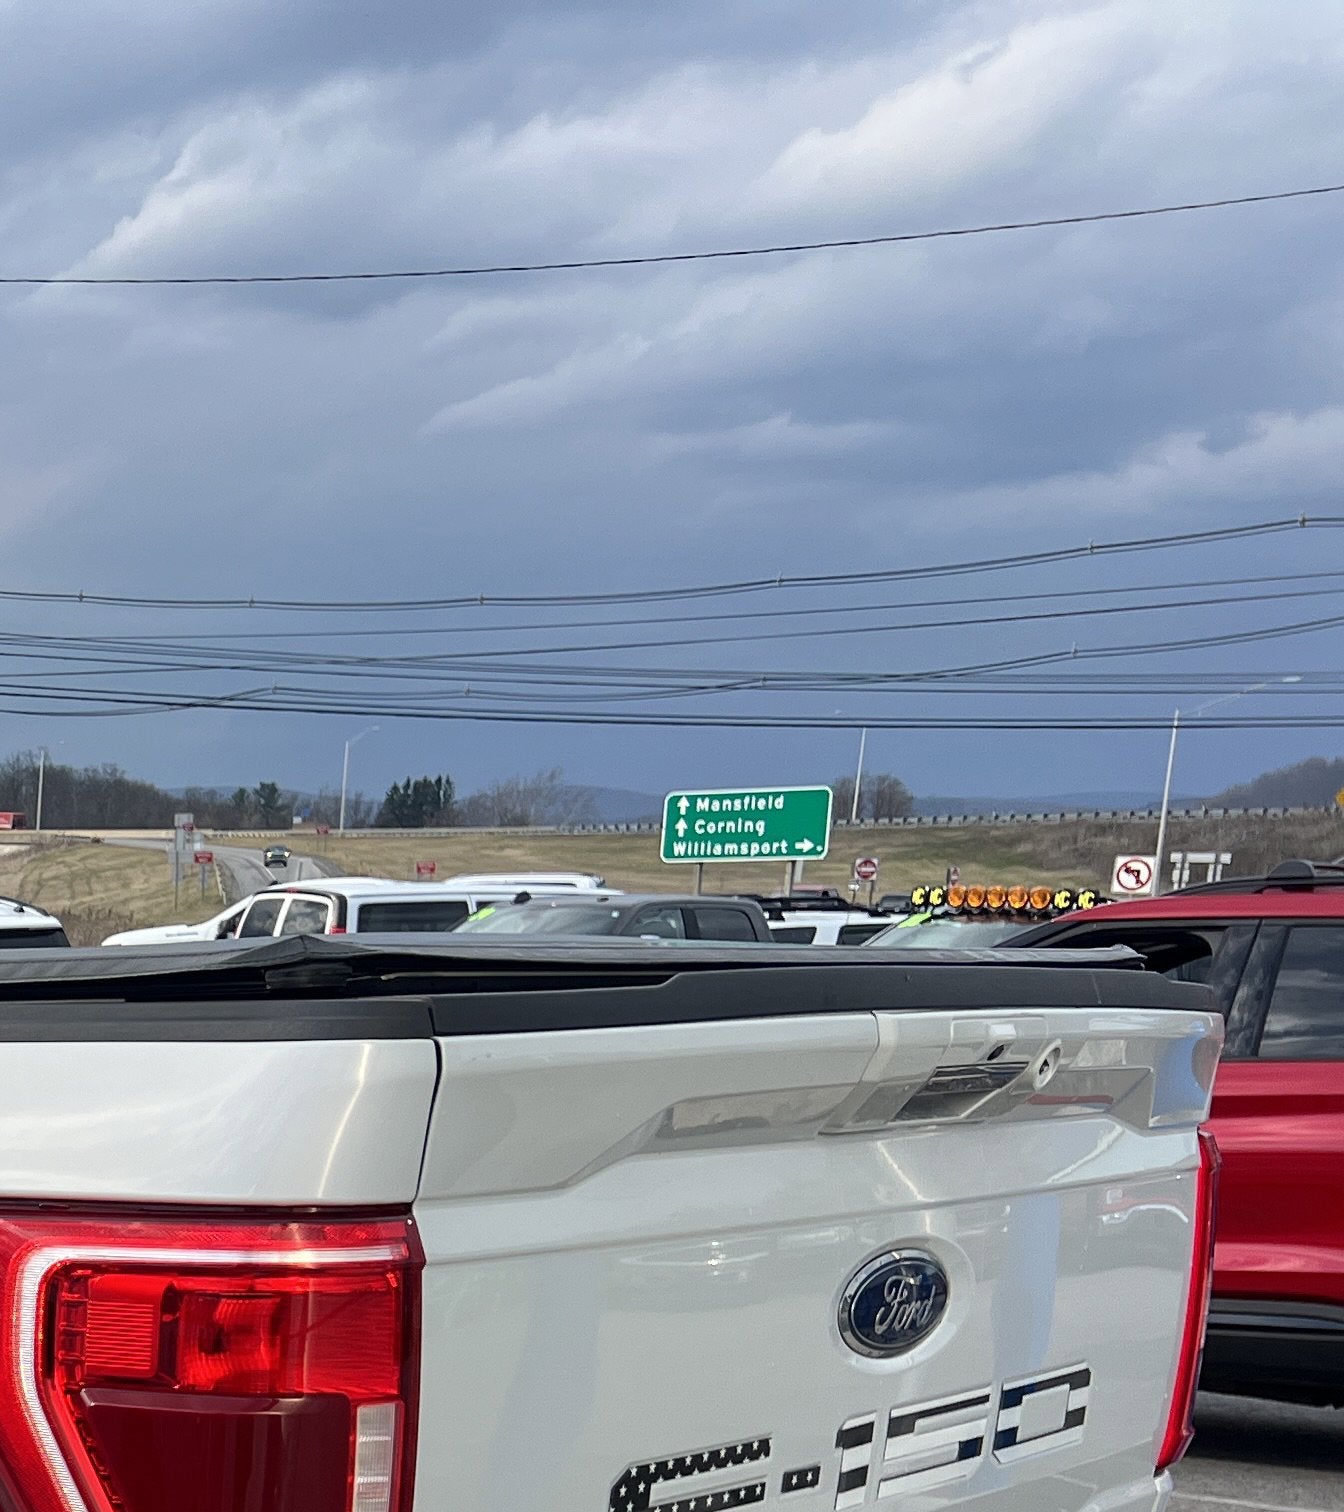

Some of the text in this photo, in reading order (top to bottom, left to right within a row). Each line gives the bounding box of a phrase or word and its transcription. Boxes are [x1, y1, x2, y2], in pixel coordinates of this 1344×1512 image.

[695, 794, 784, 813] Mansfield
[694, 817, 766, 837] Corning
[673, 838, 788, 857] Williamsport
[874, 1274, 937, 1335] Ford
